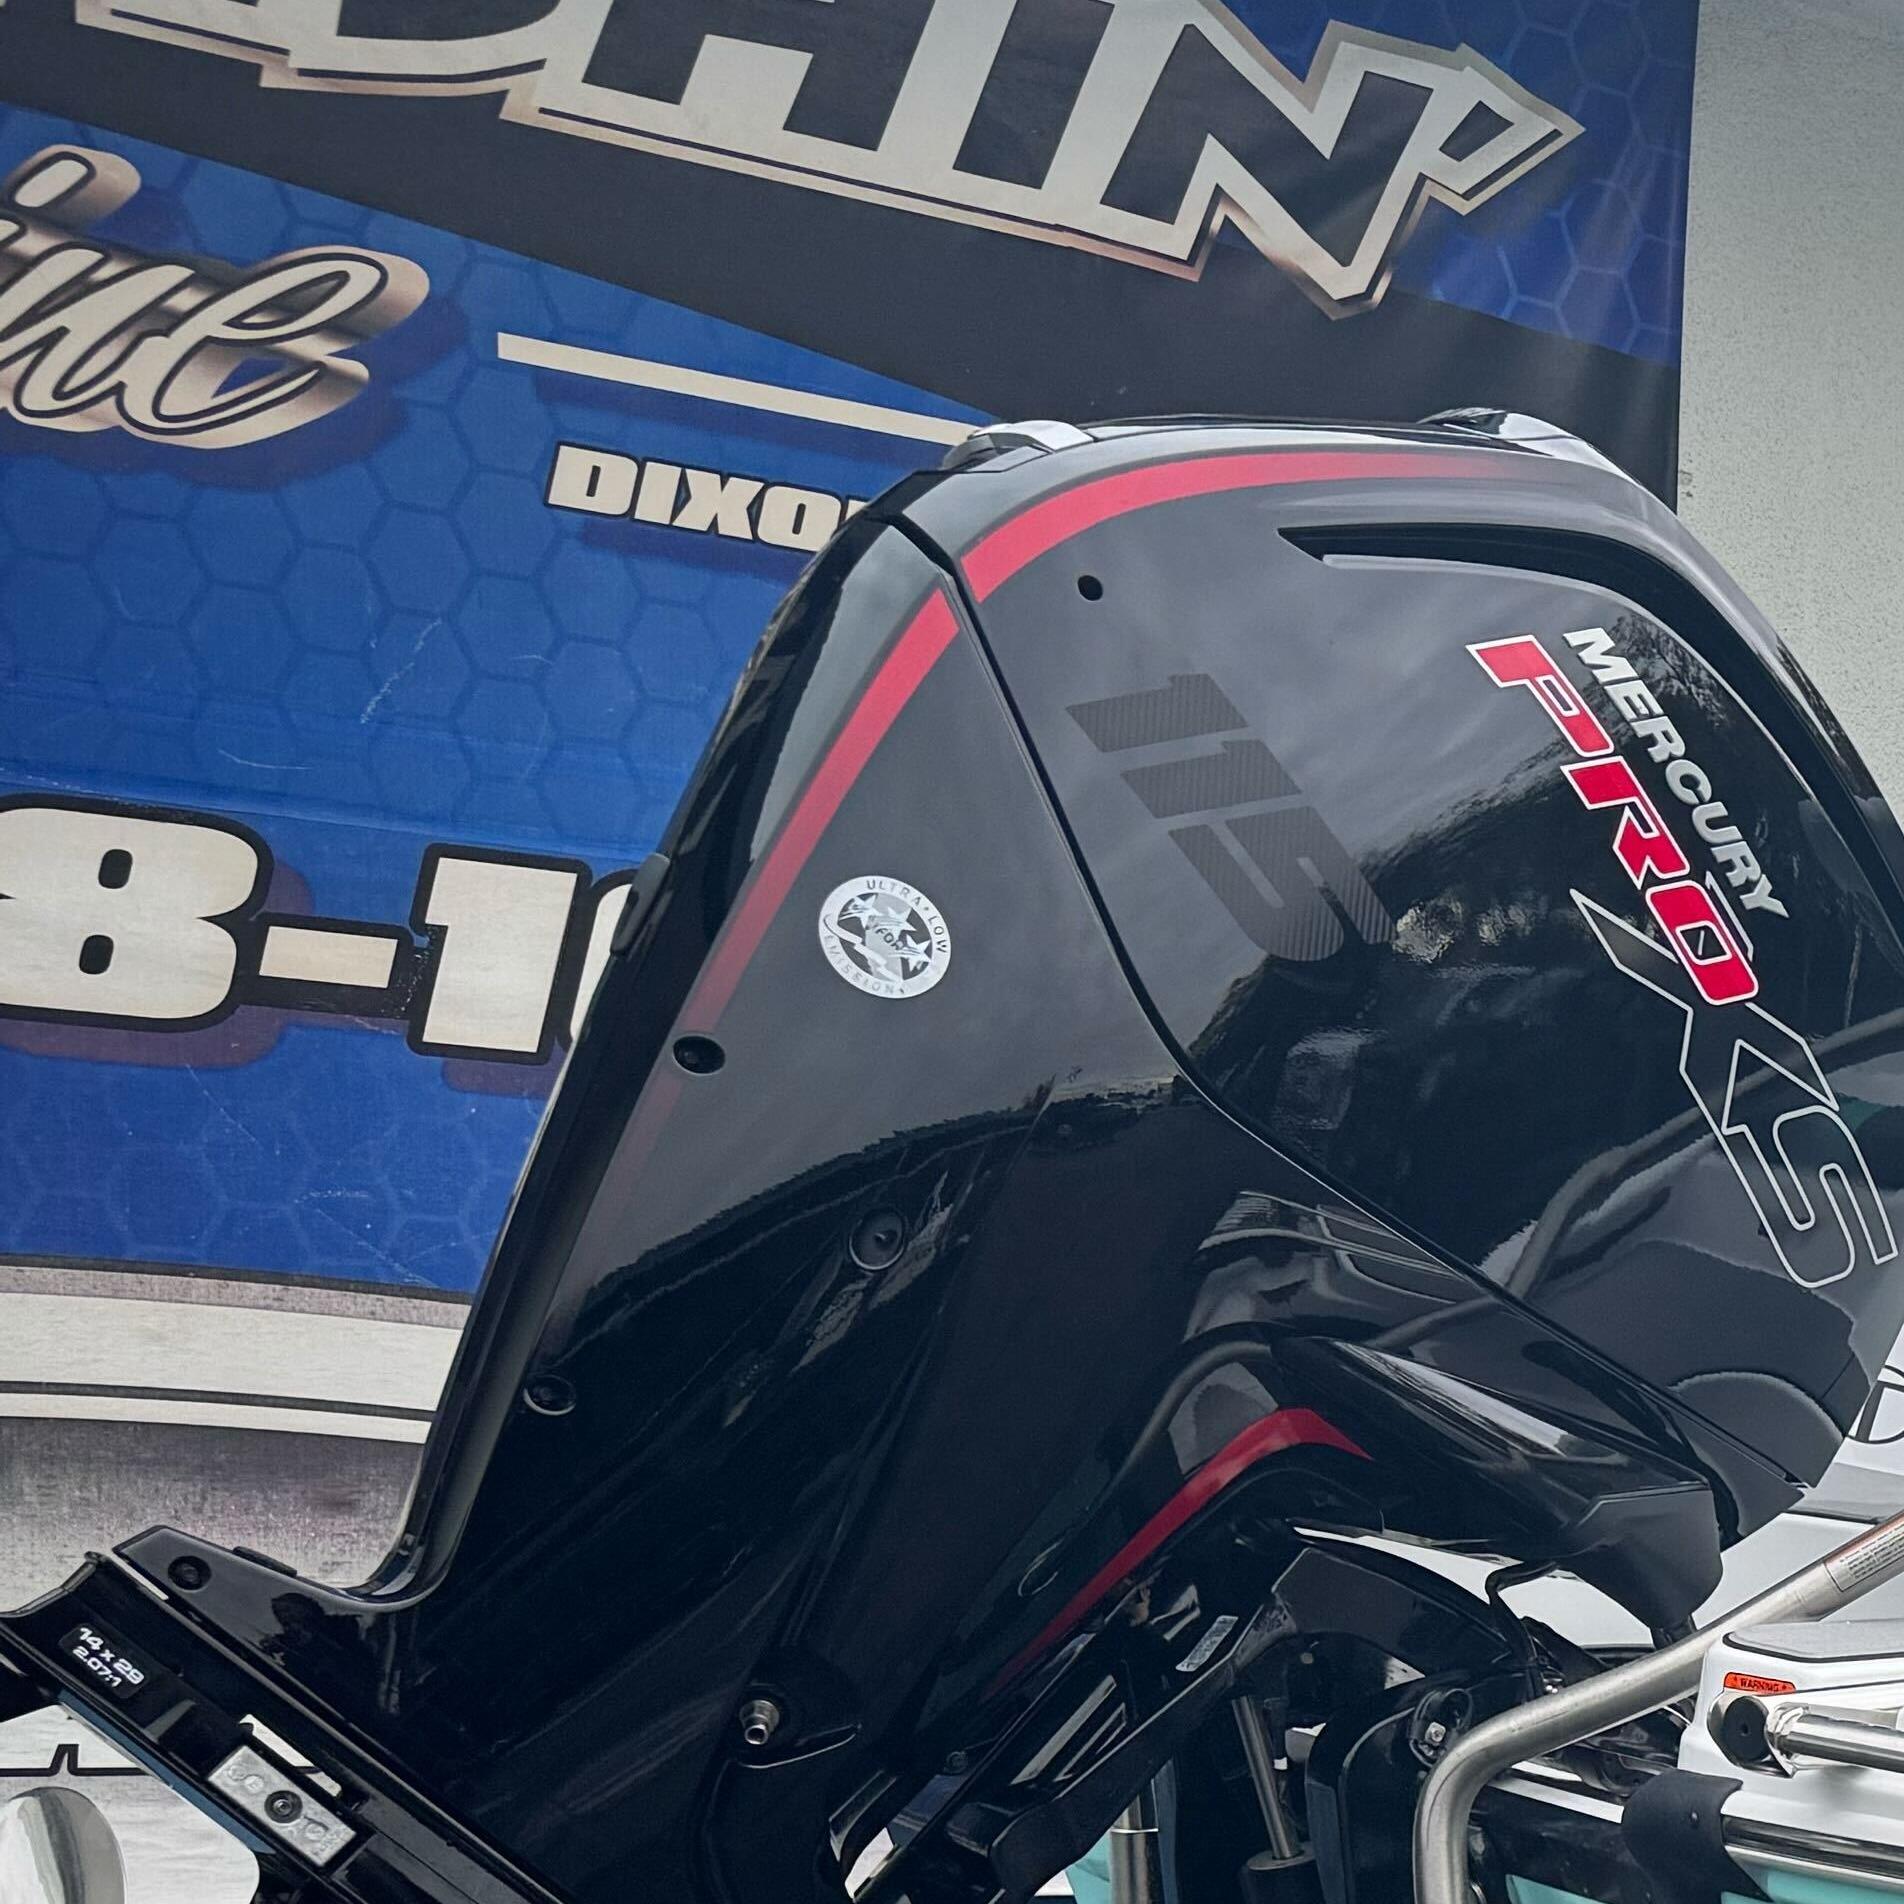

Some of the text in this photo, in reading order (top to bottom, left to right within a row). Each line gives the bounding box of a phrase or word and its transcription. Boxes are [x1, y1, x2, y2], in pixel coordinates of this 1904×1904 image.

[546, 442, 868, 553] DIXO
[1066, 672, 1400, 962] 115
[1466, 634, 1760, 1005] PRO
[1564, 626, 1789, 919] MERCURY
[0, 803, 632, 1056] 8-1
[866, 879, 921, 907] ULTRA
[928, 914, 948, 954] LOW
[72, 1645, 122, 1688] 2.07:1
[79, 1627, 104, 1650] 14
